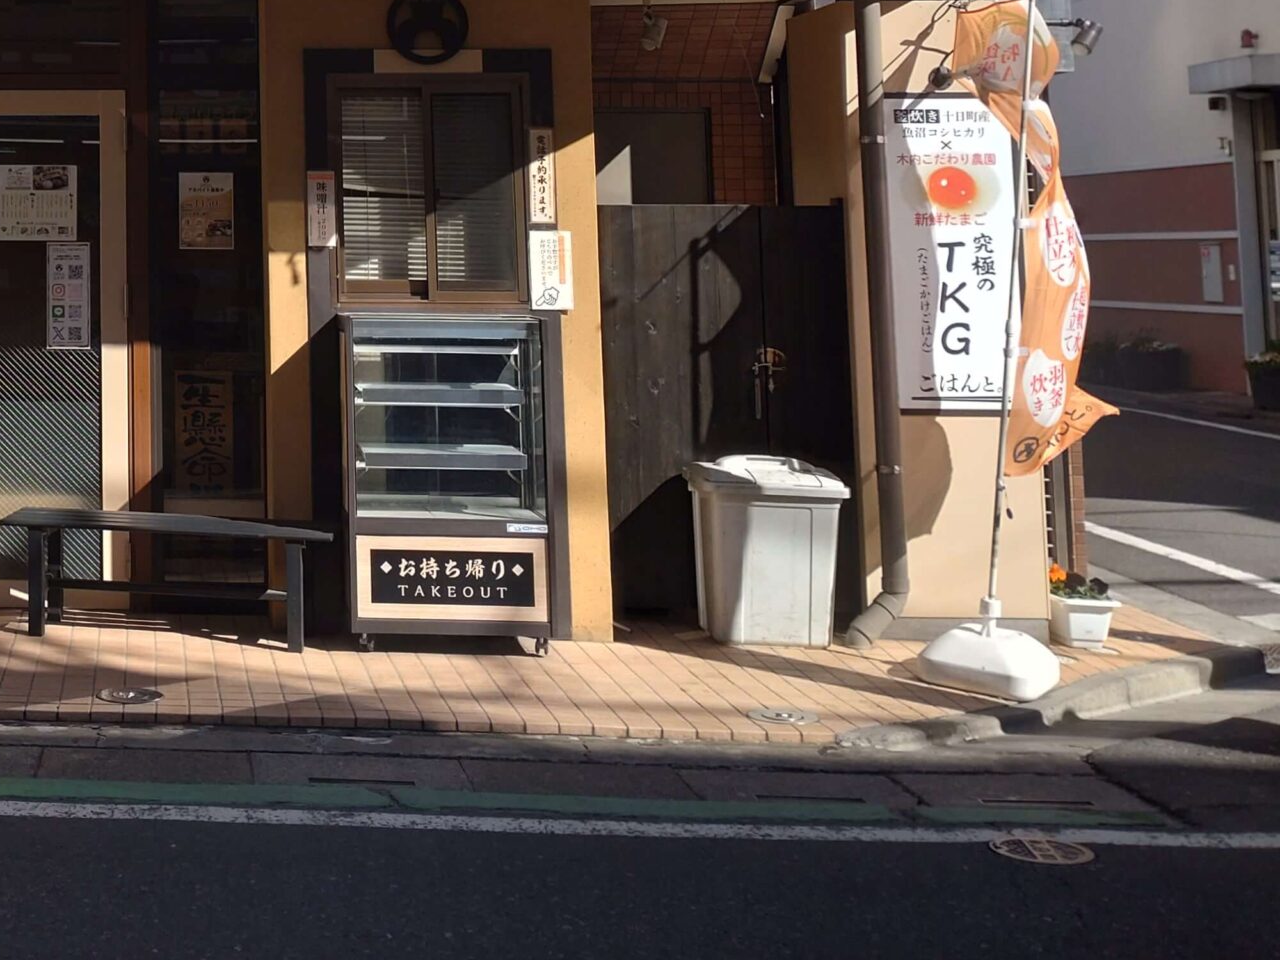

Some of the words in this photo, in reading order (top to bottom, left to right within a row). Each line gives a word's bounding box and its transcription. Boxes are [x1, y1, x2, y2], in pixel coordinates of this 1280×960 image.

[895, 110, 939, 123] 釜炊き
[943, 111, 990, 123] 十日町産
[902, 127, 985, 138] 魚沼コシヒカリ
[897, 153, 997, 166] 木内こだわり農園
[914, 212, 987, 227] 新鮮たまご
[972, 233, 996, 291] 究極の
[937, 241, 970, 355] TKG
[920, 373, 1003, 393] ごはんと。
[1031, 374, 1047, 417] 炊き
[398, 556, 506, 580] お持ち帰り
[397, 584, 507, 599] TAKEOUT
